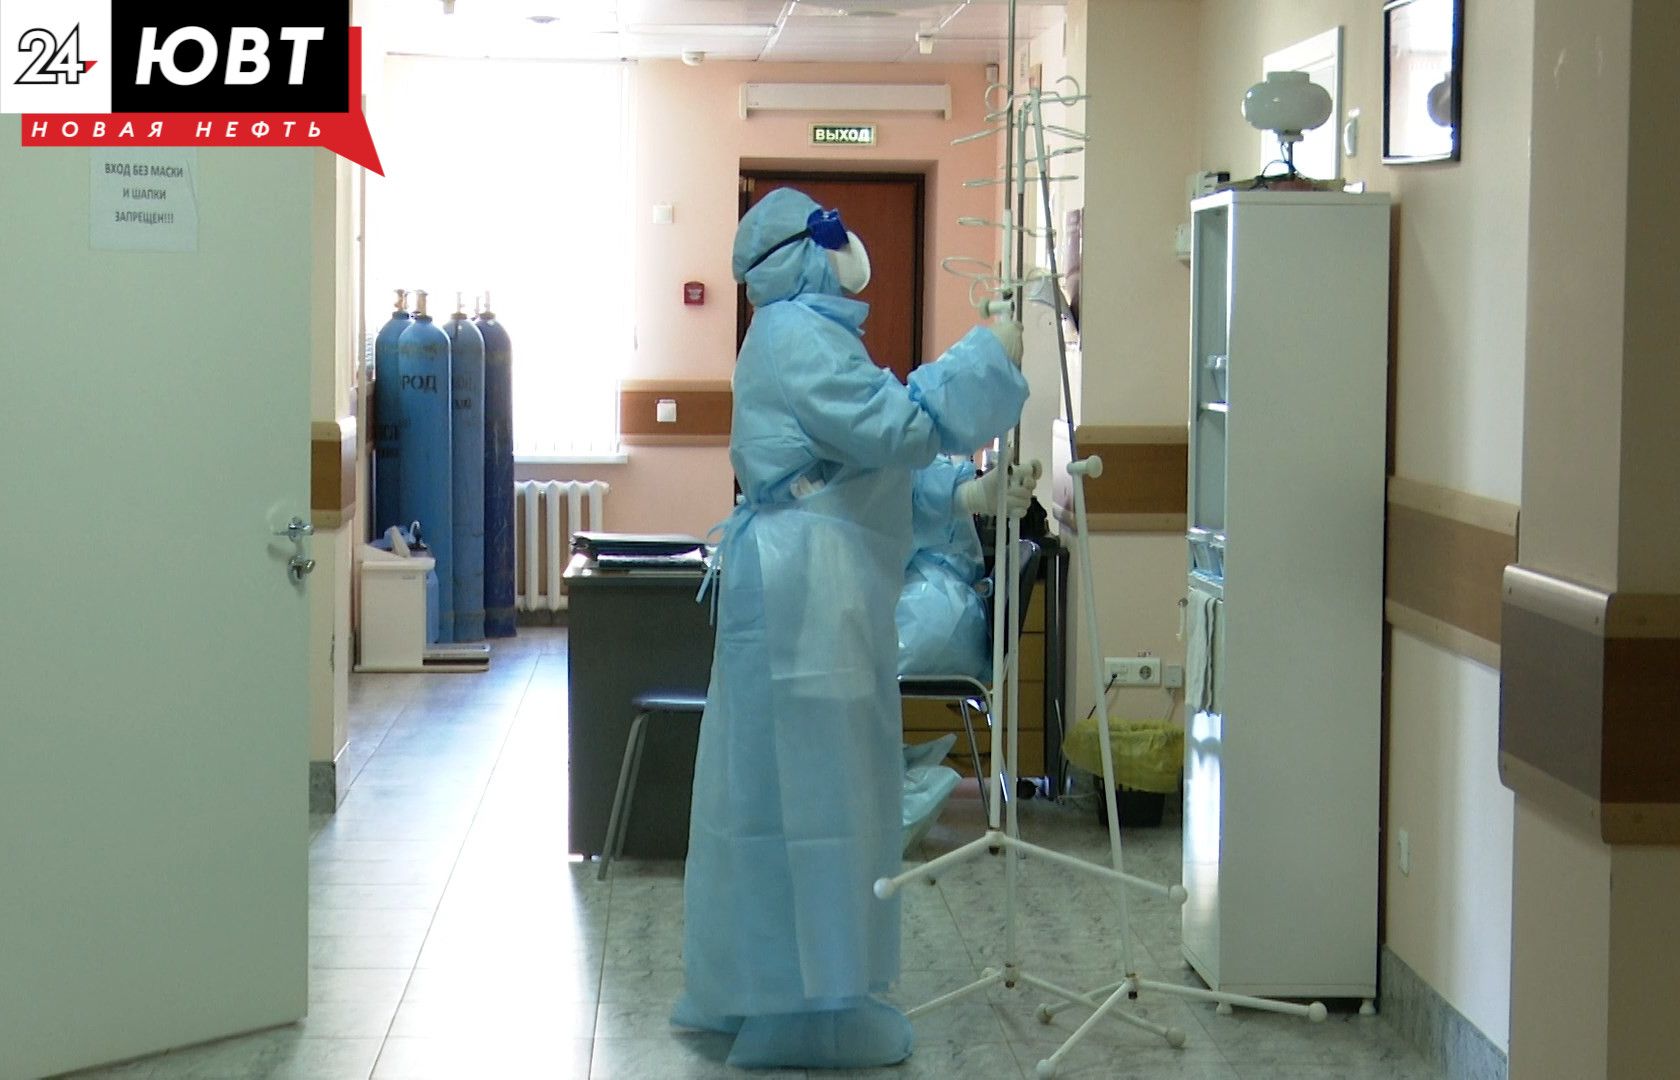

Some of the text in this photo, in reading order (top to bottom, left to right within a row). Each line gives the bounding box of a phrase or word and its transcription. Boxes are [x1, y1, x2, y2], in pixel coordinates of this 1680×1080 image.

[815, 129, 870, 142] ВЫХОД
[104, 163, 184, 178] ВХОД БЕЗ МАСКИ
[122, 188, 167, 201] И ШАПКИ
[115, 211, 175, 225] ЗАПРЕЩЕН!!!
